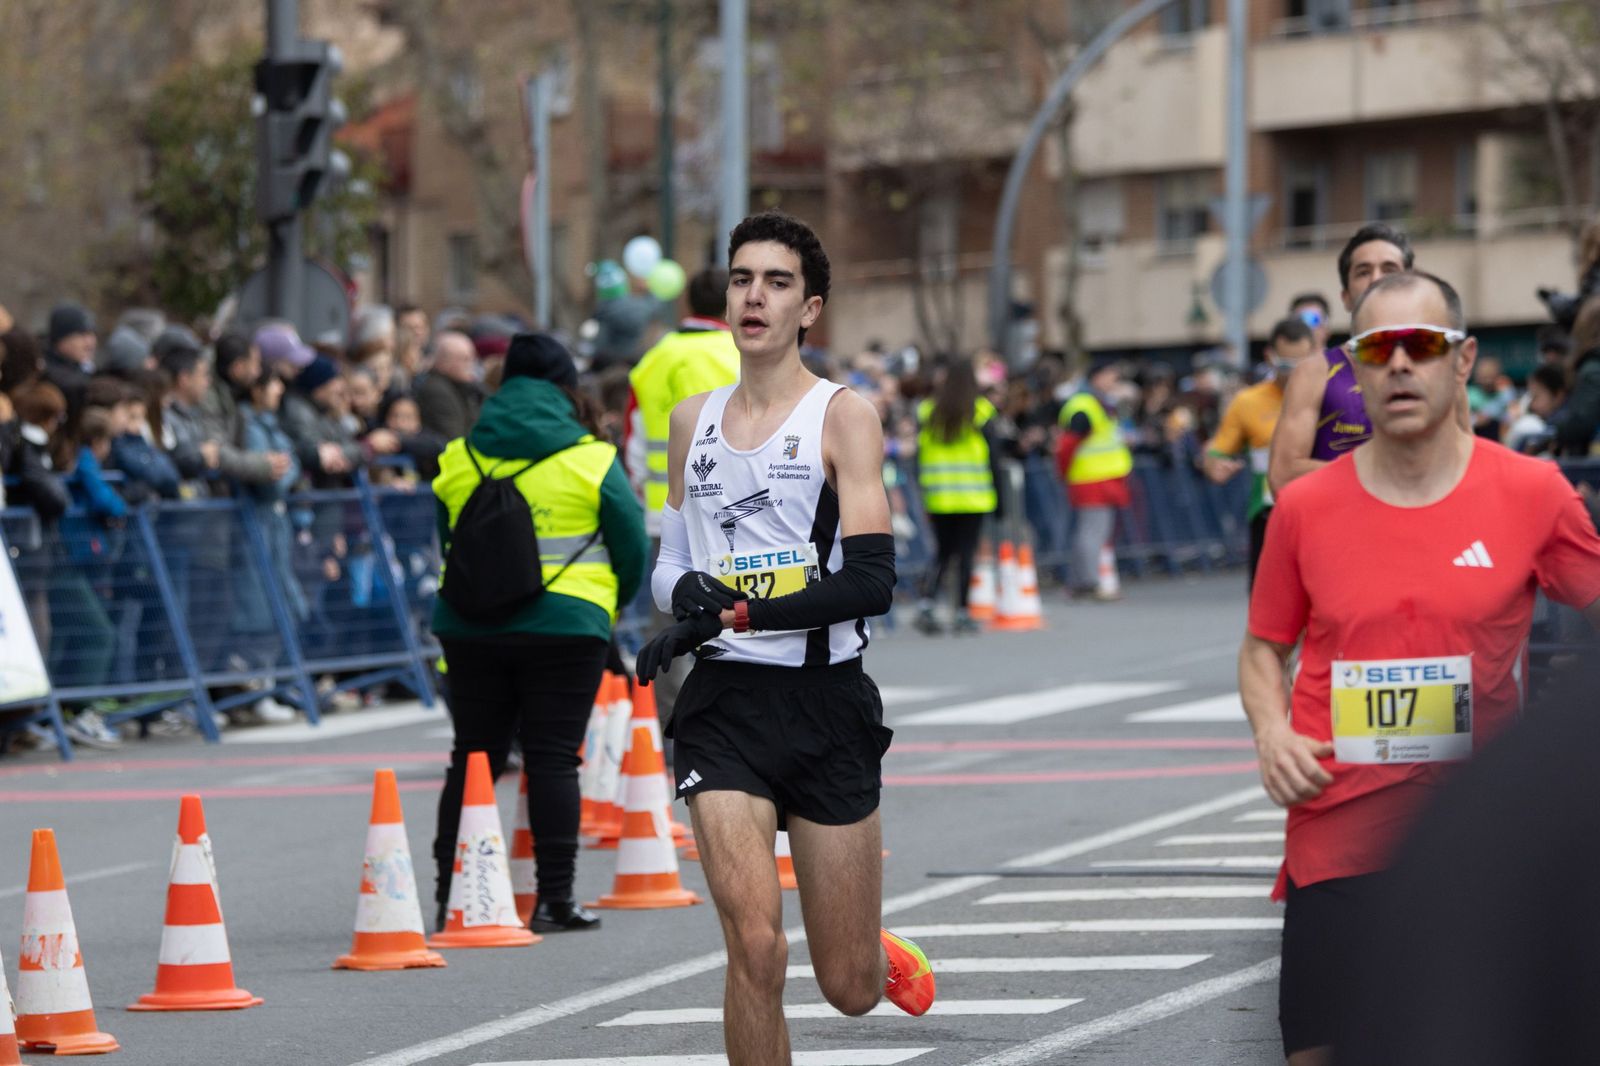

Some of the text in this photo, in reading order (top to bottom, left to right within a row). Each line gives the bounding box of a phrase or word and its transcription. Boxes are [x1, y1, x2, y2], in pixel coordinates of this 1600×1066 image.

[695, 437, 718, 447] VIATOR
[768, 463, 811, 472] Ayuntamiento
[776, 472, 810, 480] Salamanca
[700, 483, 724, 492] RURAL
[734, 550, 806, 571] SETEL
[1366, 664, 1457, 683] SETEL
[1366, 687, 1418, 728] 107
